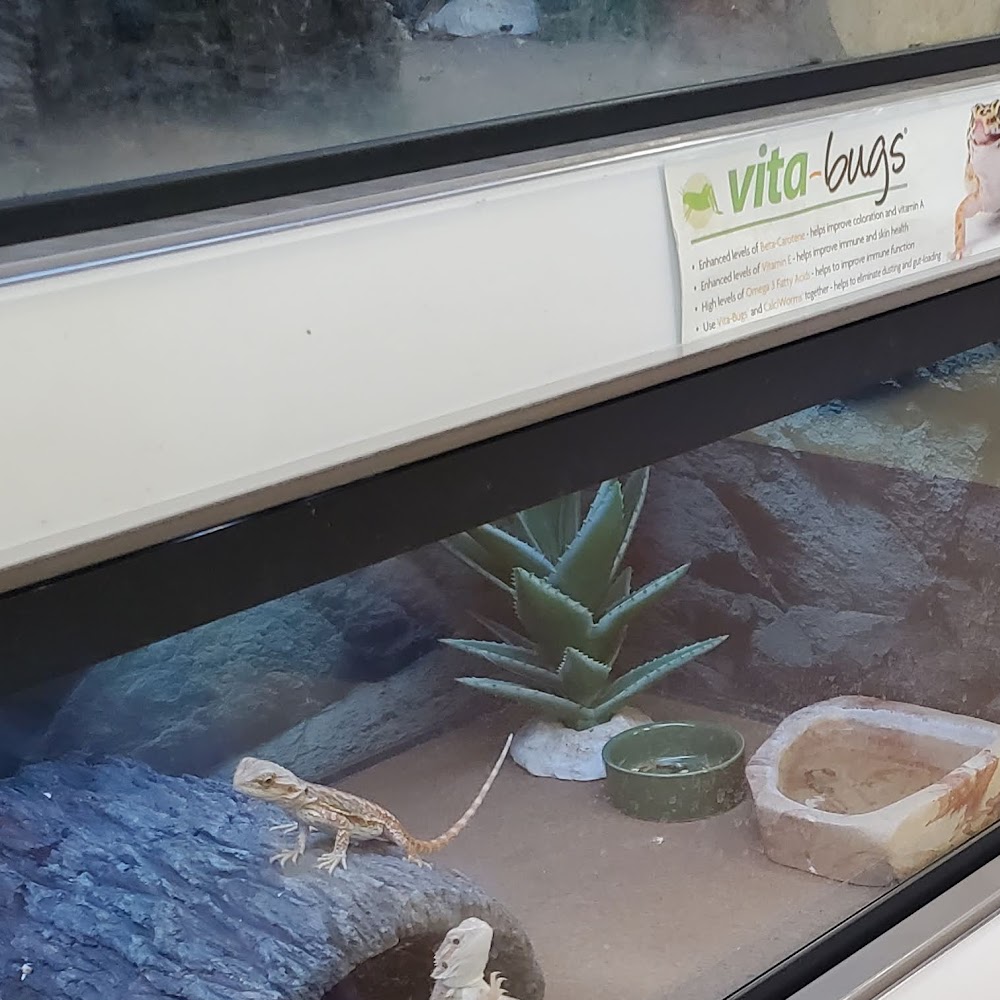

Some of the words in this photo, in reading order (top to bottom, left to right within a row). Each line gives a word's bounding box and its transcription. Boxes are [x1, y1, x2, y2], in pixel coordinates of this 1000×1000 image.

[698, 249, 731, 270] Enhanced
[730, 245, 750, 260] levels
[750, 240, 758, 254] of
[759, 232, 805, 251] Beta-Carotene
[809, 223, 825, 238] helps
[826, 216, 851, 233] improve
[852, 210, 884, 225] coloration
[884, 204, 896, 217] and
[897, 200, 919, 214] vitamin
[700, 270, 732, 290] Enhanced
[732, 265, 751, 281] levels
[752, 261, 760, 275] of
[761, 258, 786, 271] Vitamin
[795, 248, 812, 262] helps
[812, 243, 838, 257] improve
[838, 235, 864, 249] immune
[865, 228, 877, 242] and
[877, 226, 890, 239] skin
[890, 221, 908, 236] health
[701, 297, 716, 312] High
[717, 291, 736, 306] levels
[737, 287, 744, 300] of
[745, 284, 769, 297] Omega
[776, 277, 792, 288] Fatty
[814, 263, 831, 277] helps
[831, 259, 839, 272] to
[840, 255, 865, 269] improve
[866, 248, 889, 262] immune
[890, 241, 915, 255] function
